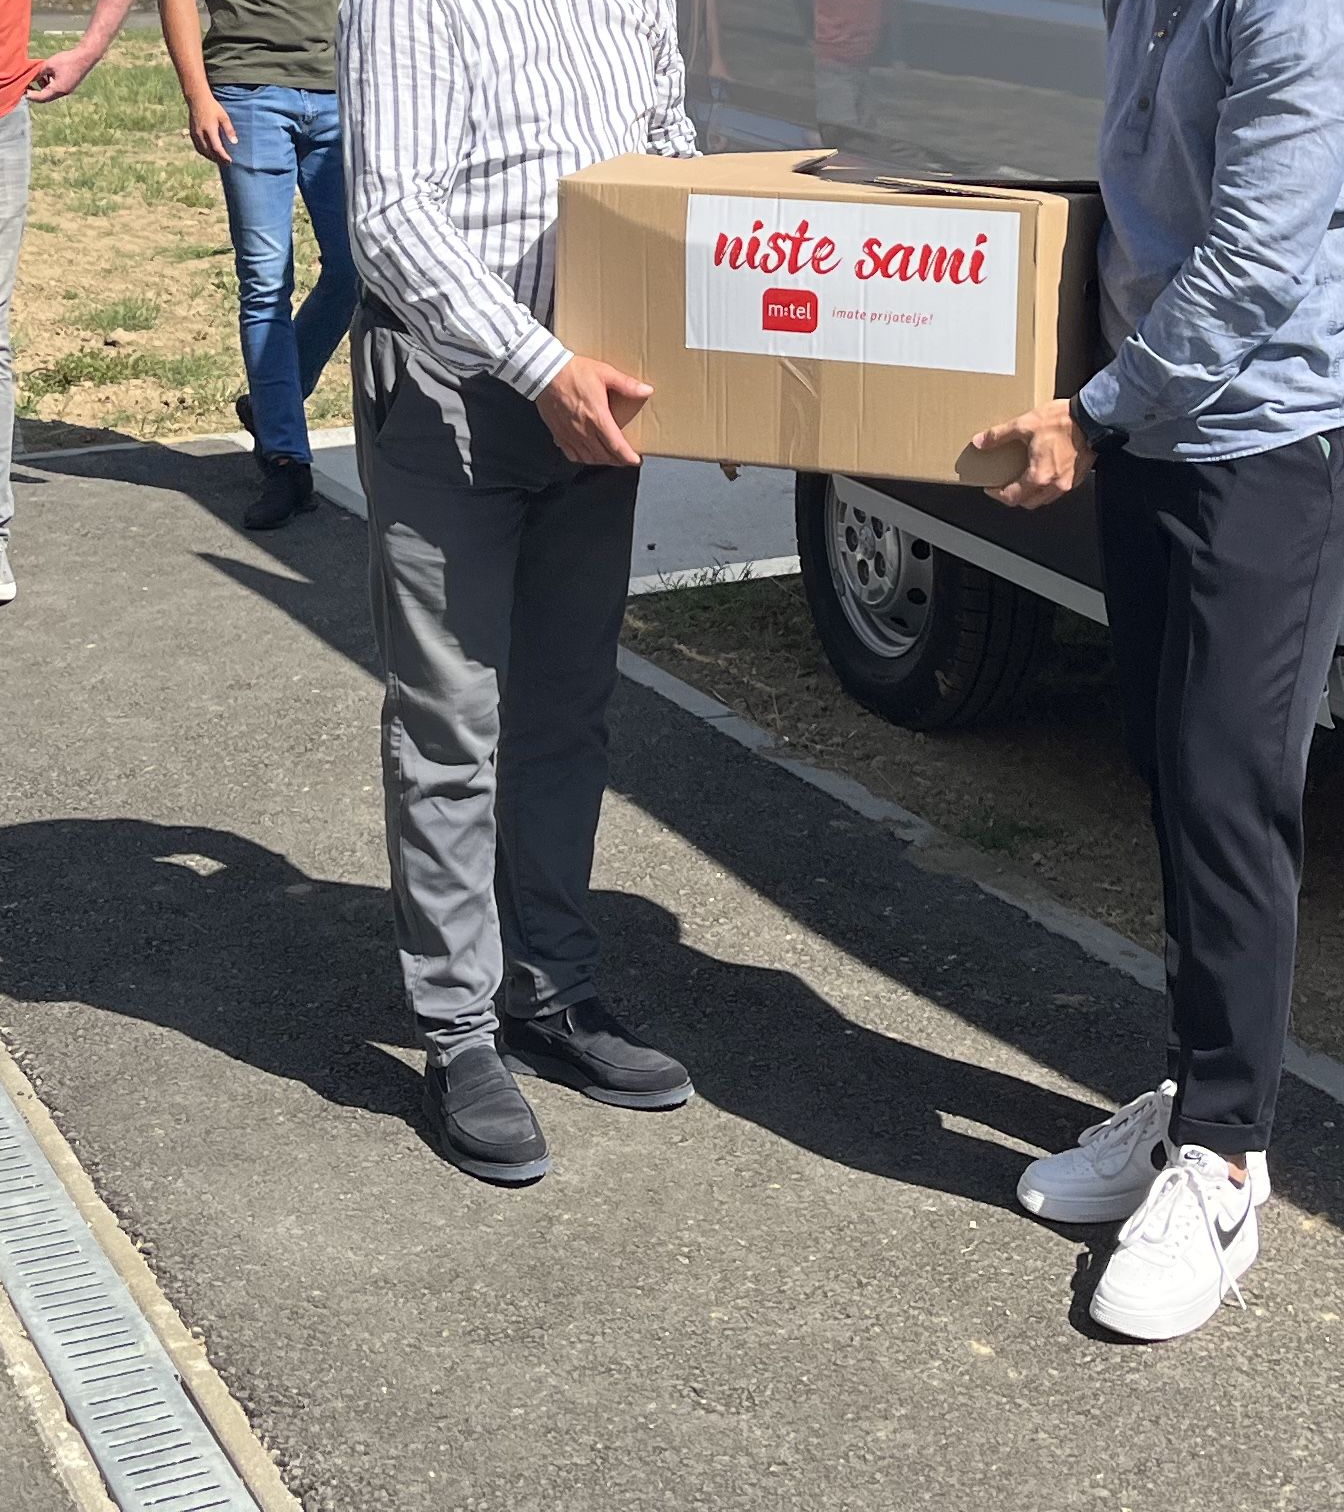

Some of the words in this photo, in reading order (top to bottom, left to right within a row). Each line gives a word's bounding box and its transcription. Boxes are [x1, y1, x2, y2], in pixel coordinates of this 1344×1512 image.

[713, 219, 842, 275] niste
[854, 233, 989, 285] sami
[768, 302, 812, 320] m:tel
[832, 307, 866, 320] imate
[870, 310, 934, 327] prijatelje!
